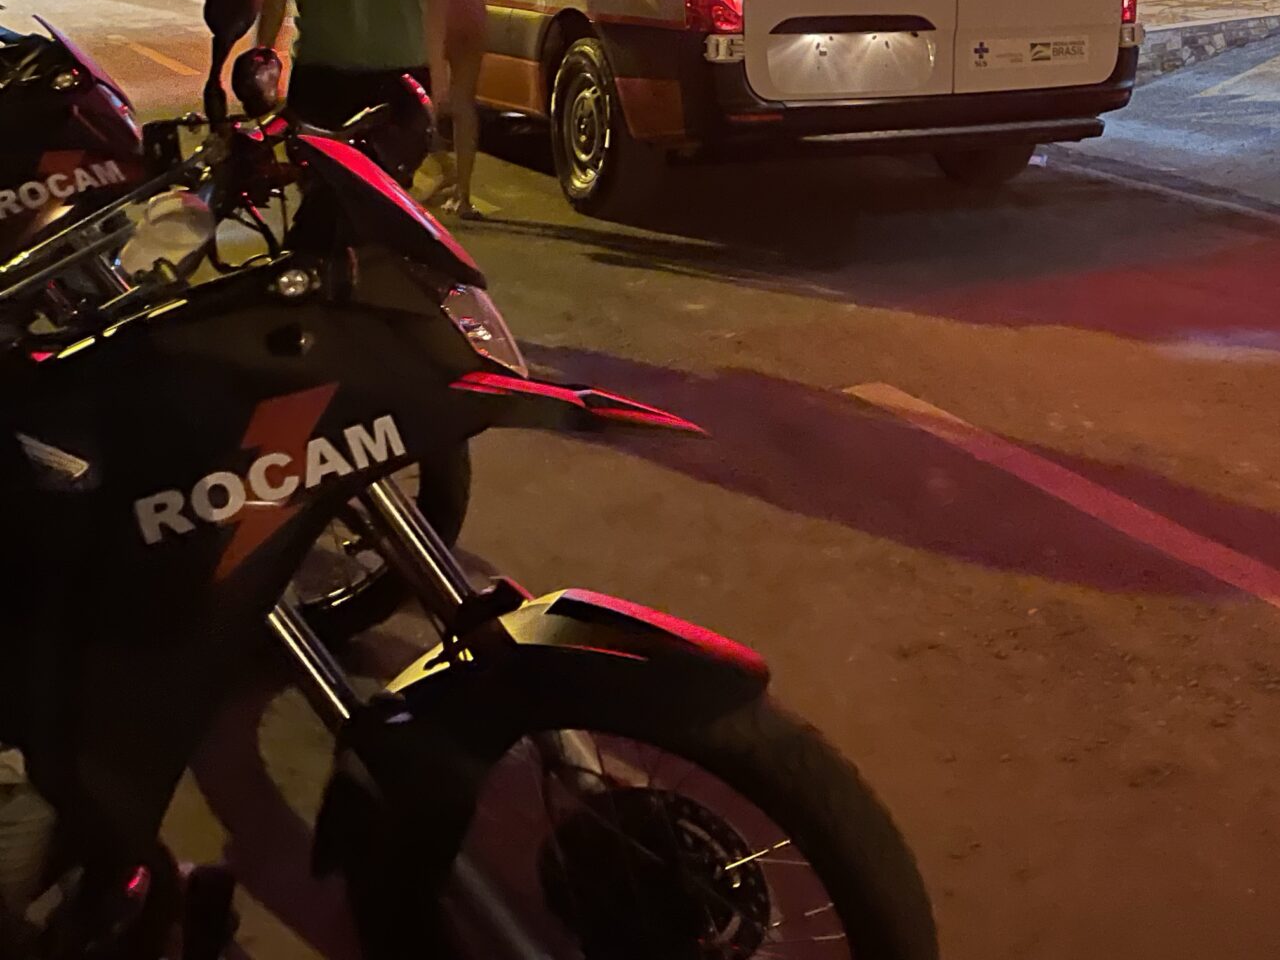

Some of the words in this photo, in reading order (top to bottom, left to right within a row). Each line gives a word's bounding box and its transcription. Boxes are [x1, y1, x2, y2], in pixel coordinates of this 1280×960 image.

[1052, 46, 1085, 57] BRASIL
[0, 159, 126, 220] ROCAM
[133, 414, 407, 546] ROCAM
